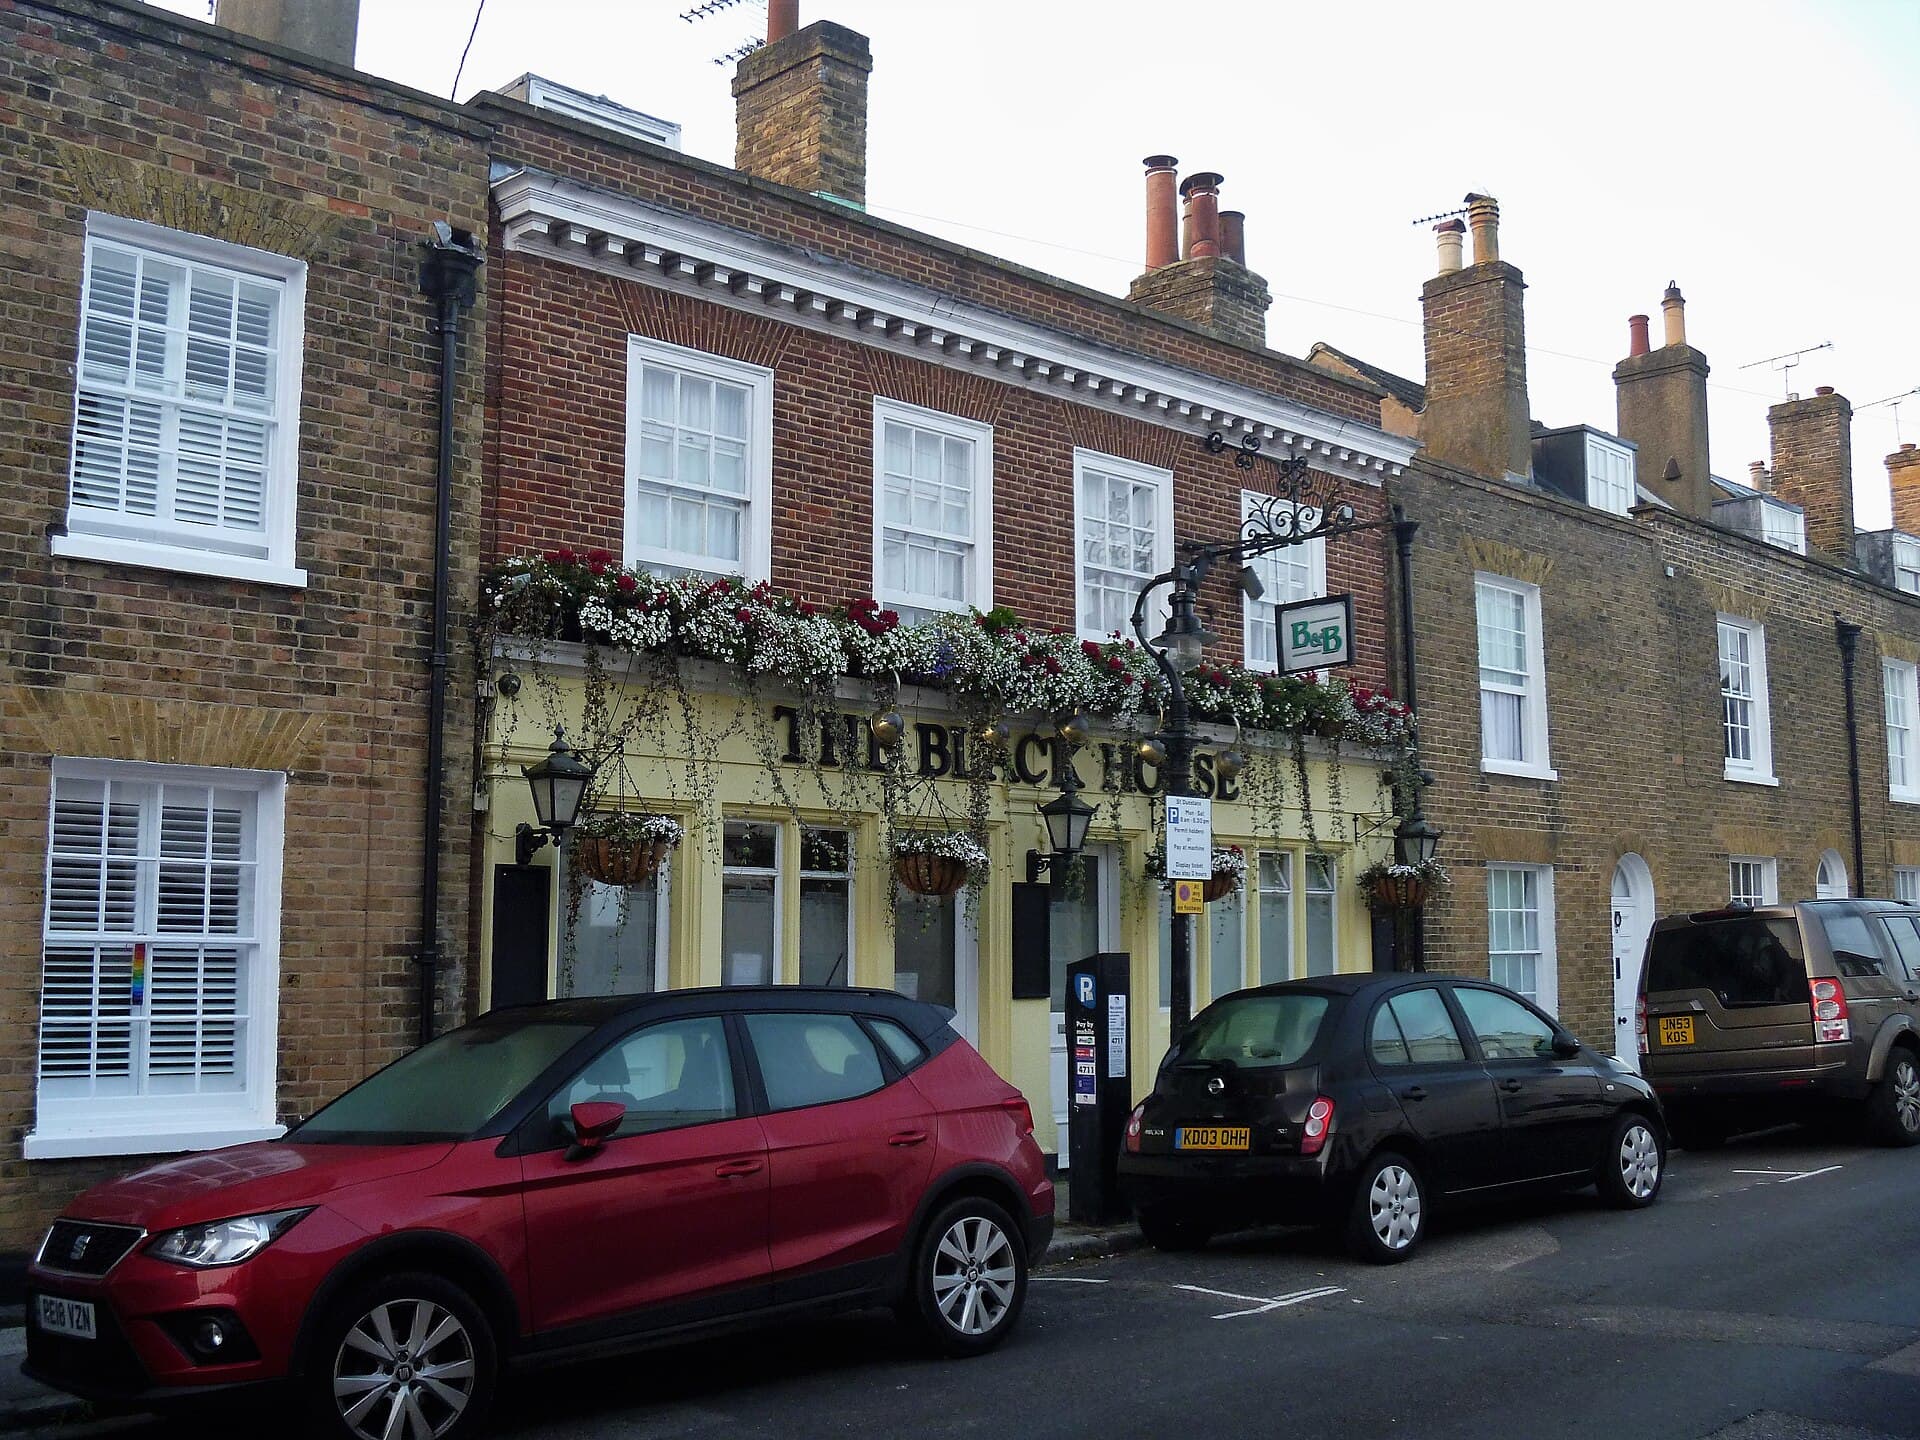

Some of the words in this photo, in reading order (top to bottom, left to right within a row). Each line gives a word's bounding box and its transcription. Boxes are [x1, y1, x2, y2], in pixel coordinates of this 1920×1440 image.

[1291, 621, 1342, 654] B&B
[1099, 743, 1240, 800] HOSE
[1076, 1020, 1086, 1028] Pay
[1087, 1020, 1094, 1028] by
[1663, 1018, 1690, 1030] JN53
[1079, 1066, 1094, 1074] 4711
[1183, 1130, 1217, 1145] KD03
[1221, 1130, 1247, 1145] OHH
[67, 1303, 91, 1332] VZN
